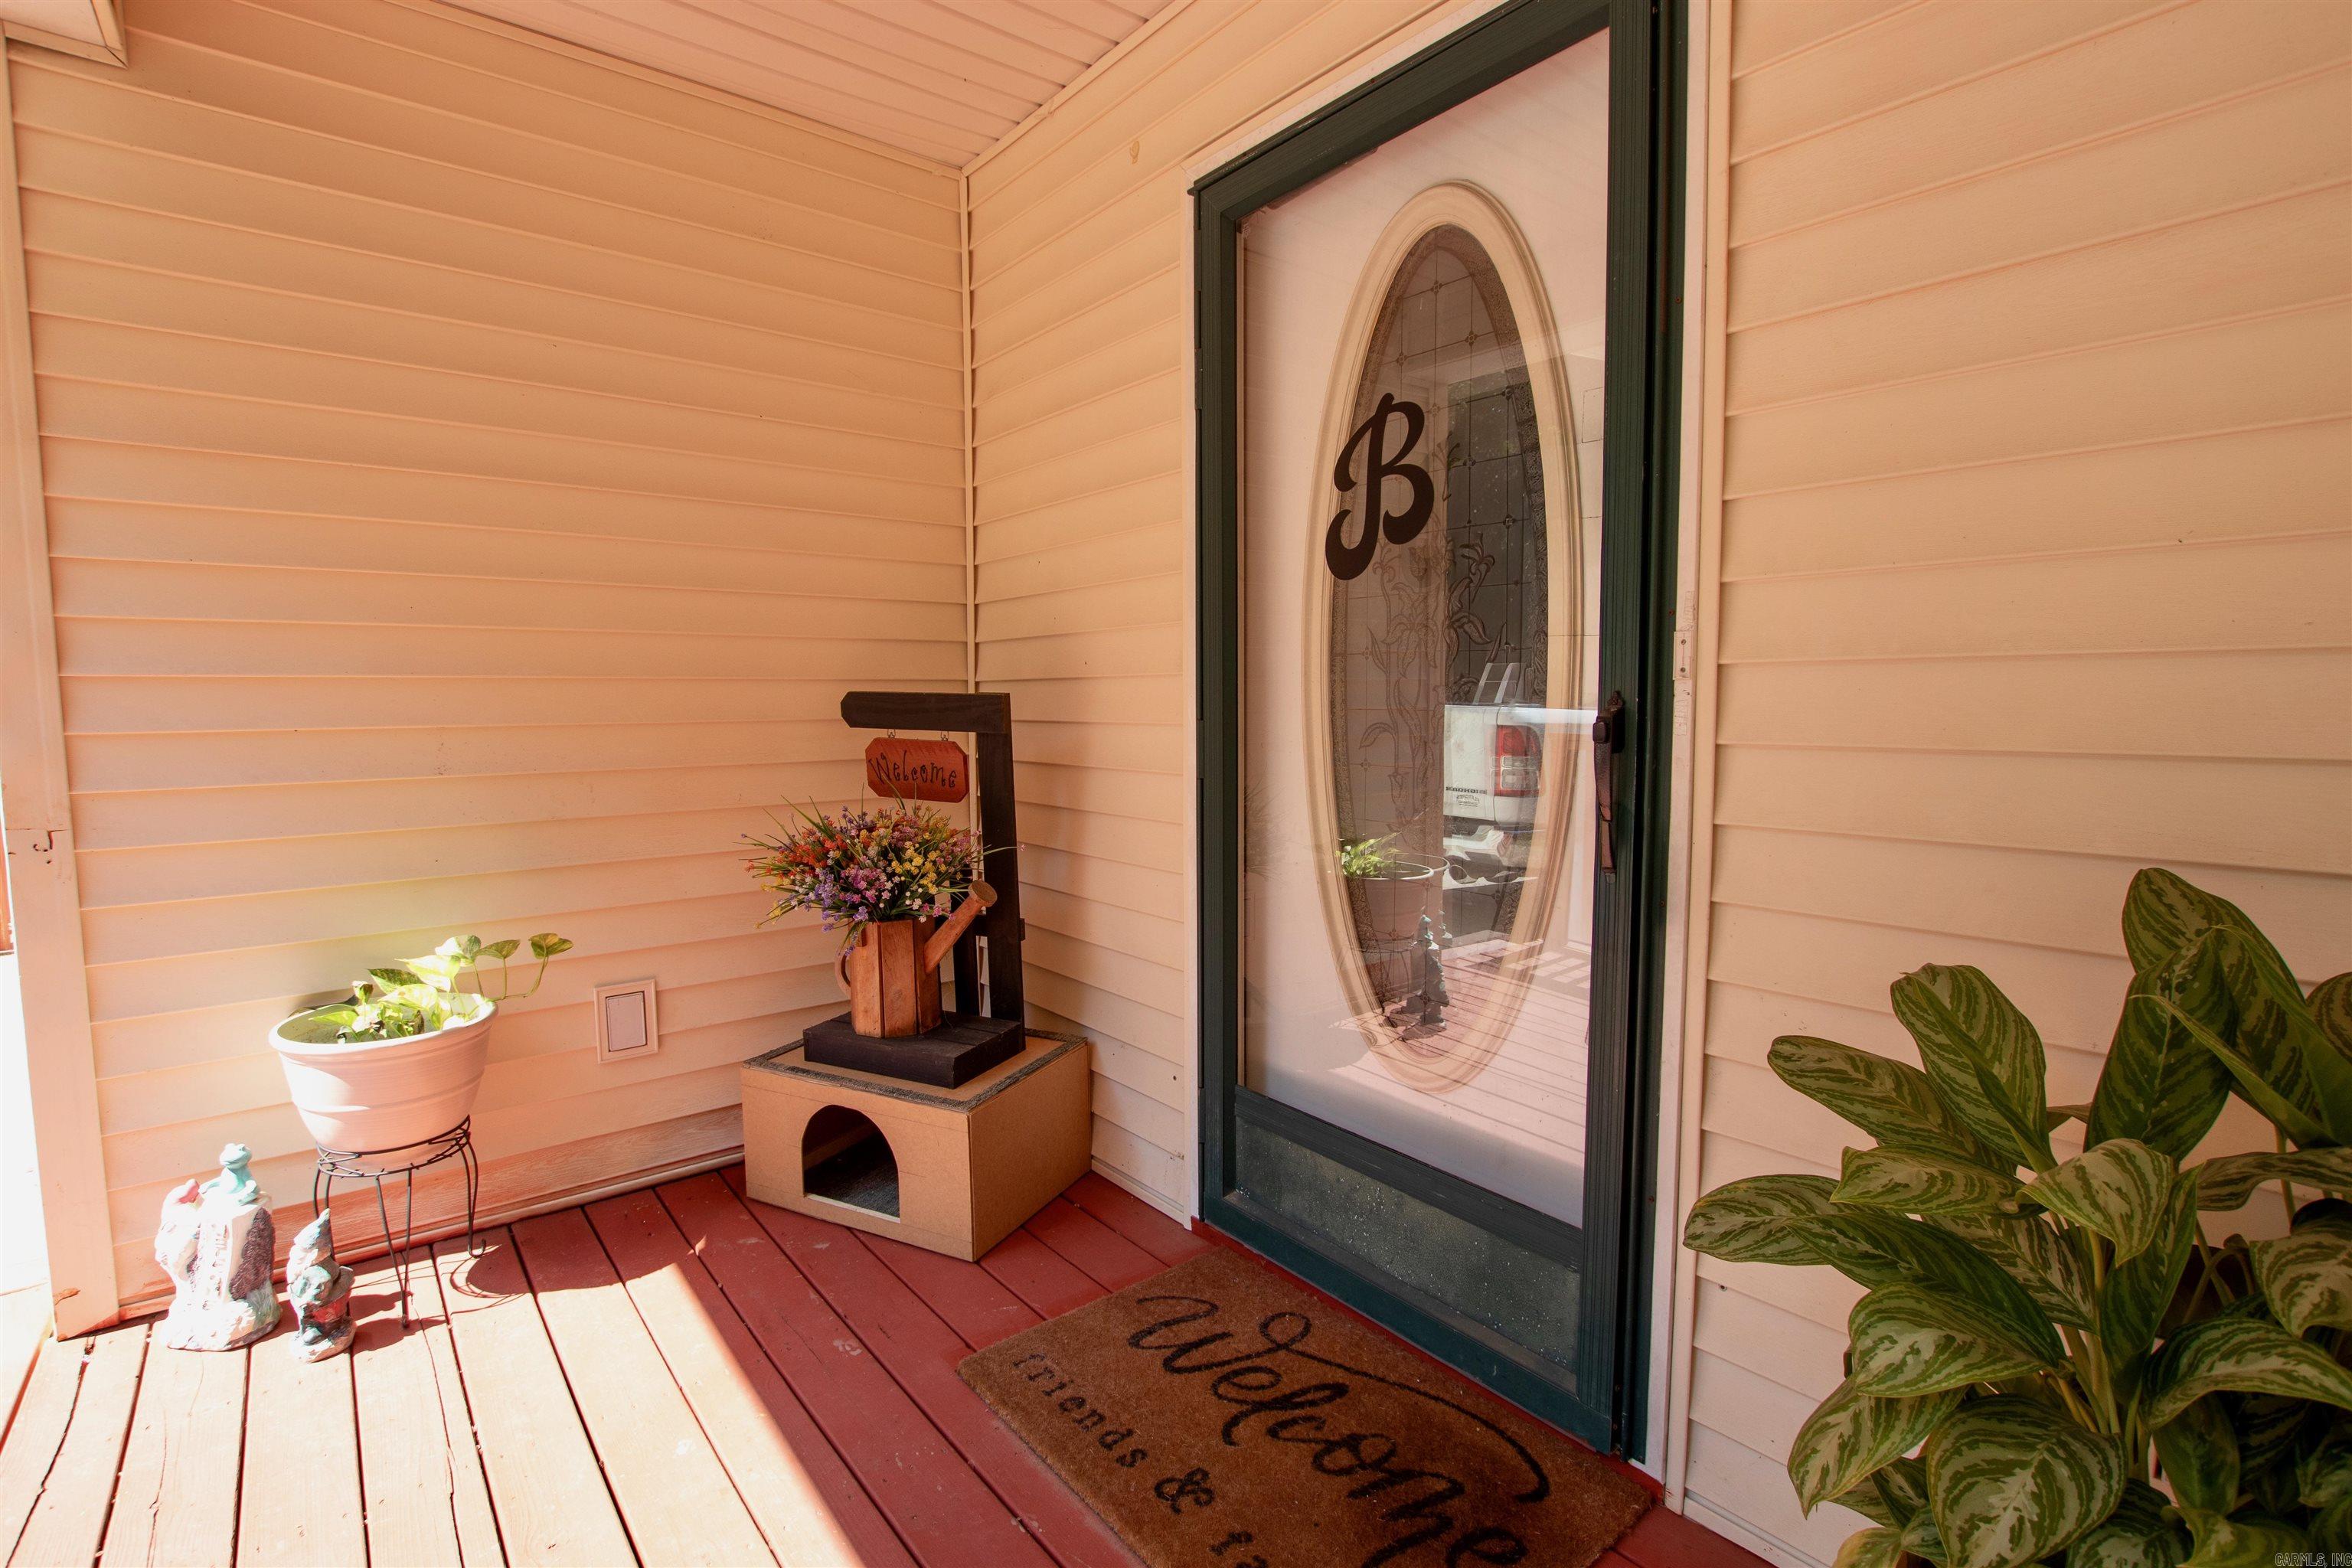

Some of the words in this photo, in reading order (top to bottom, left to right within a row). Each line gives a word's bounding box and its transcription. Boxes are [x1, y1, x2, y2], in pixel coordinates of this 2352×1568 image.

[1325, 393, 1435, 580] B
[868, 750, 958, 788] Welcome
[1013, 1353, 1148, 1468] friends
[1154, 1467, 1215, 1514] &
[1129, 1295, 1549, 1568] Welcome
